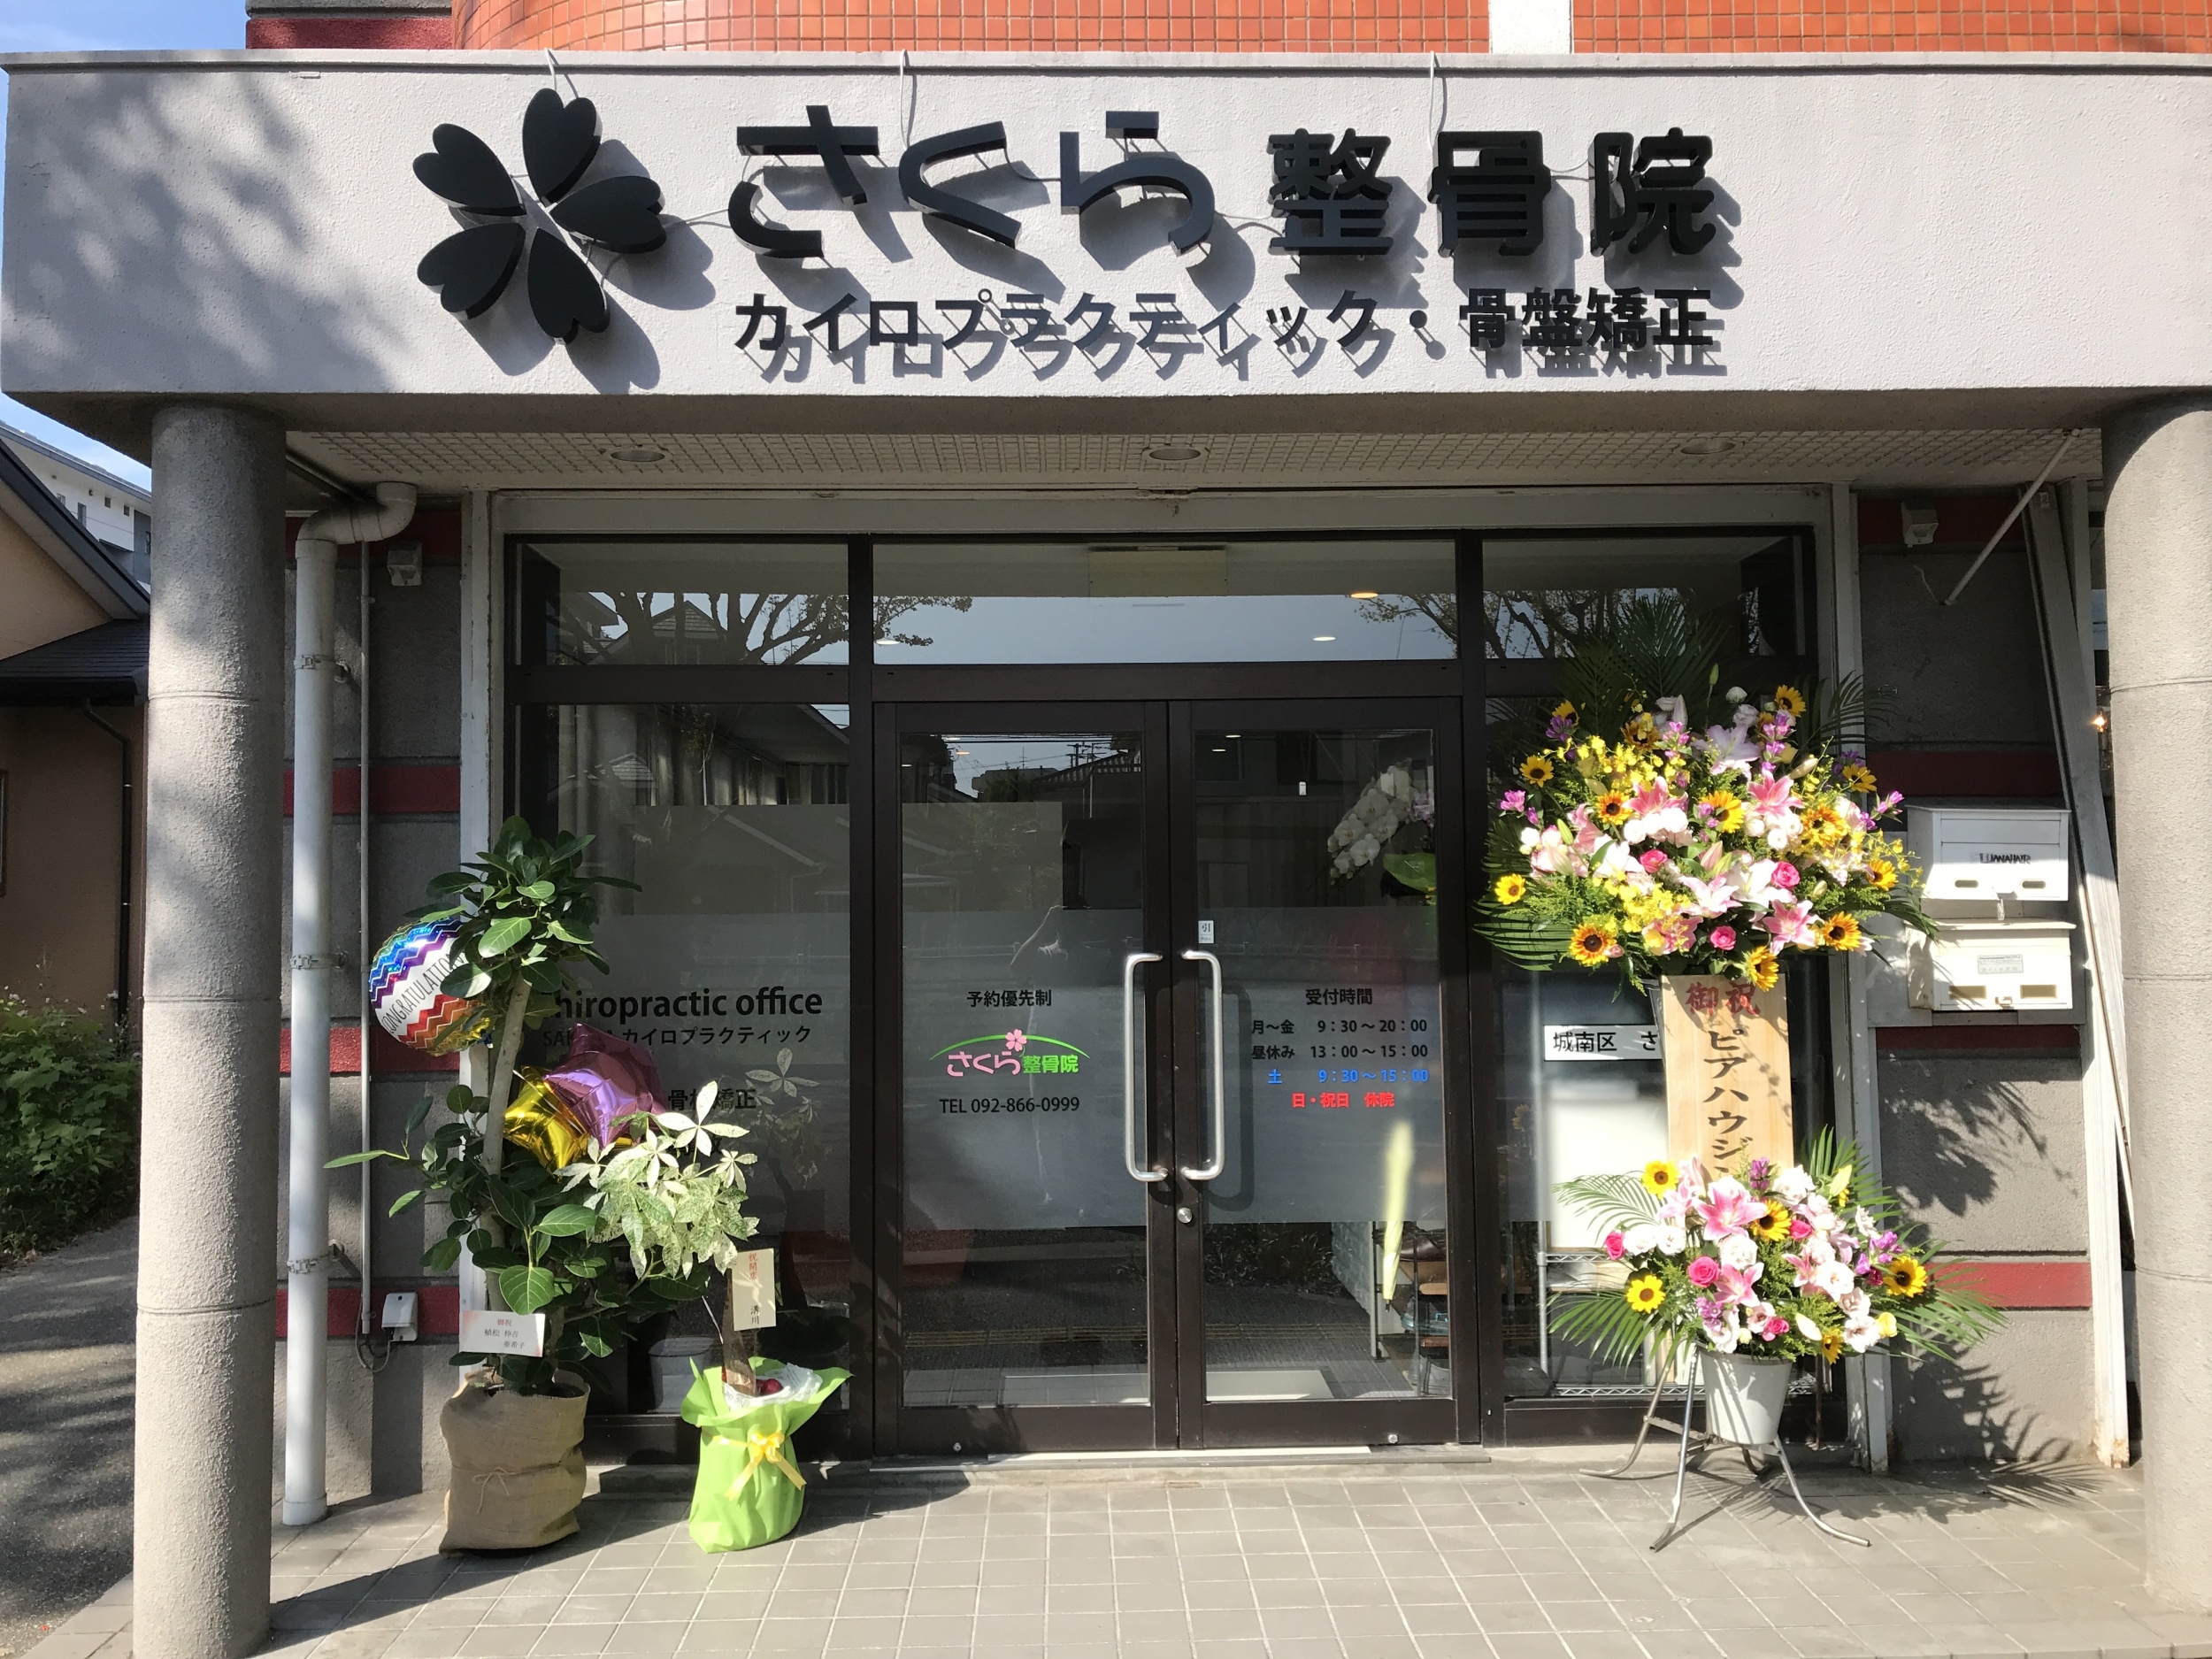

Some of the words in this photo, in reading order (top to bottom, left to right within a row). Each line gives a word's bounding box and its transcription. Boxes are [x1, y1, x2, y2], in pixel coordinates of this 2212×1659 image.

[728, 105, 1717, 258] さくら整骨院
[1202, 923, 1210, 933] 引
[541, 987, 726, 1025] hiropractic
[735, 986, 823, 1015] office
[966, 989, 1052, 1008] 予約優先制
[1305, 988, 1372, 1005] 受付時間
[1685, 980, 1761, 1017] 御祝
[622, 1025, 811, 1045] カイロプラクティック
[1553, 1031, 1617, 1053] 城南区
[1251, 1045, 1295, 1060] 昼休み
[947, 1051, 1079, 1077] さくら整骨院
[1267, 1069, 1282, 1084] 土
[668, 1088, 757, 1110] 骨矯正
[939, 1099, 967, 1114] TEL
[971, 1096, 1080, 1113] 092-866-0999
[1363, 1092, 1394, 1108] 休院
